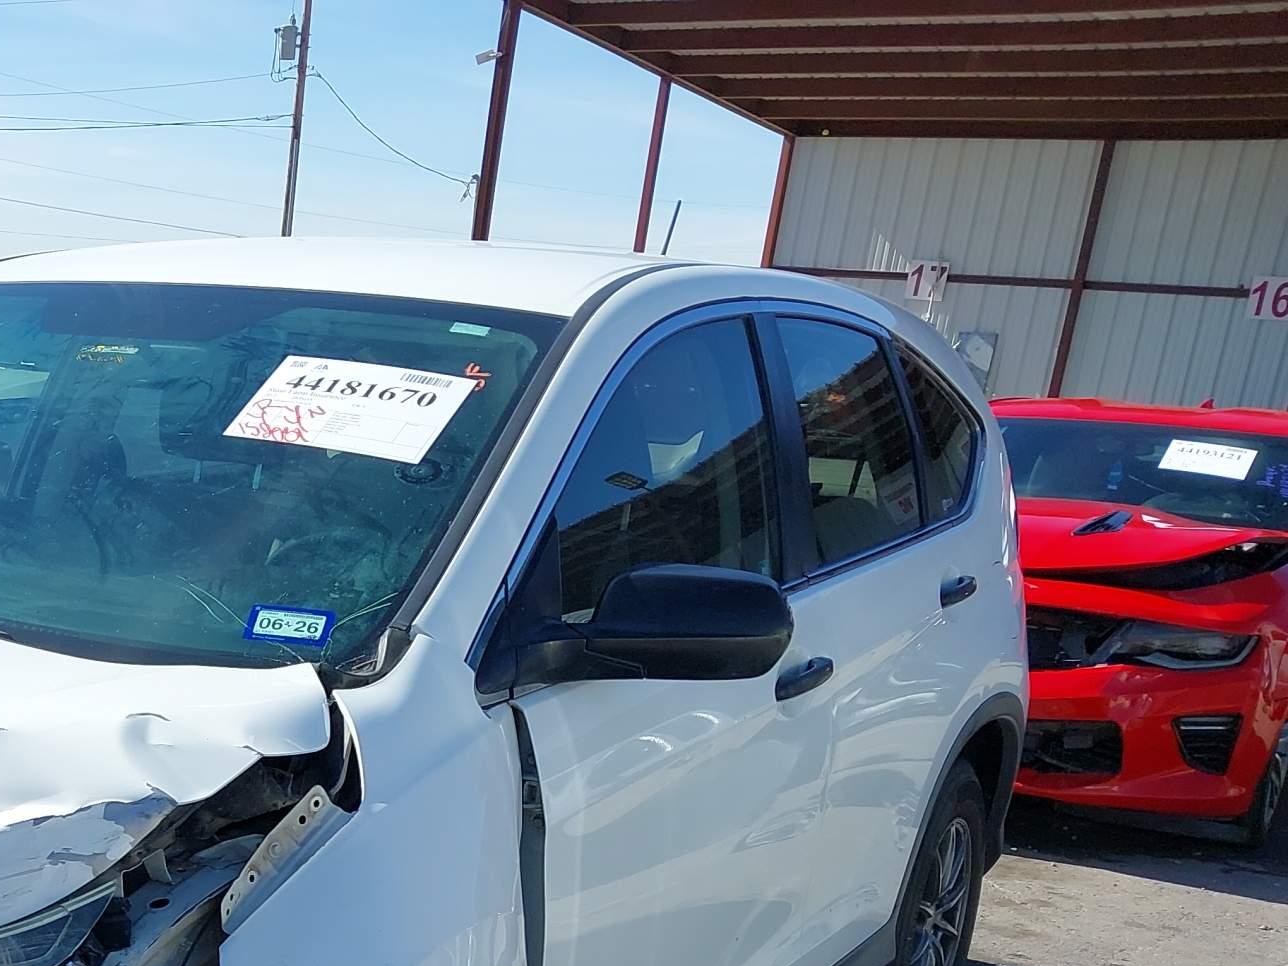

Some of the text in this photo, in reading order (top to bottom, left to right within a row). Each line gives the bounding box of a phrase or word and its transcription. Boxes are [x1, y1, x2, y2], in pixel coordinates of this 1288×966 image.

[911, 264, 948, 298] 17
[1252, 281, 1288, 318] 16
[286, 375, 437, 408] 44181670
[259, 617, 320, 634] 06 26
